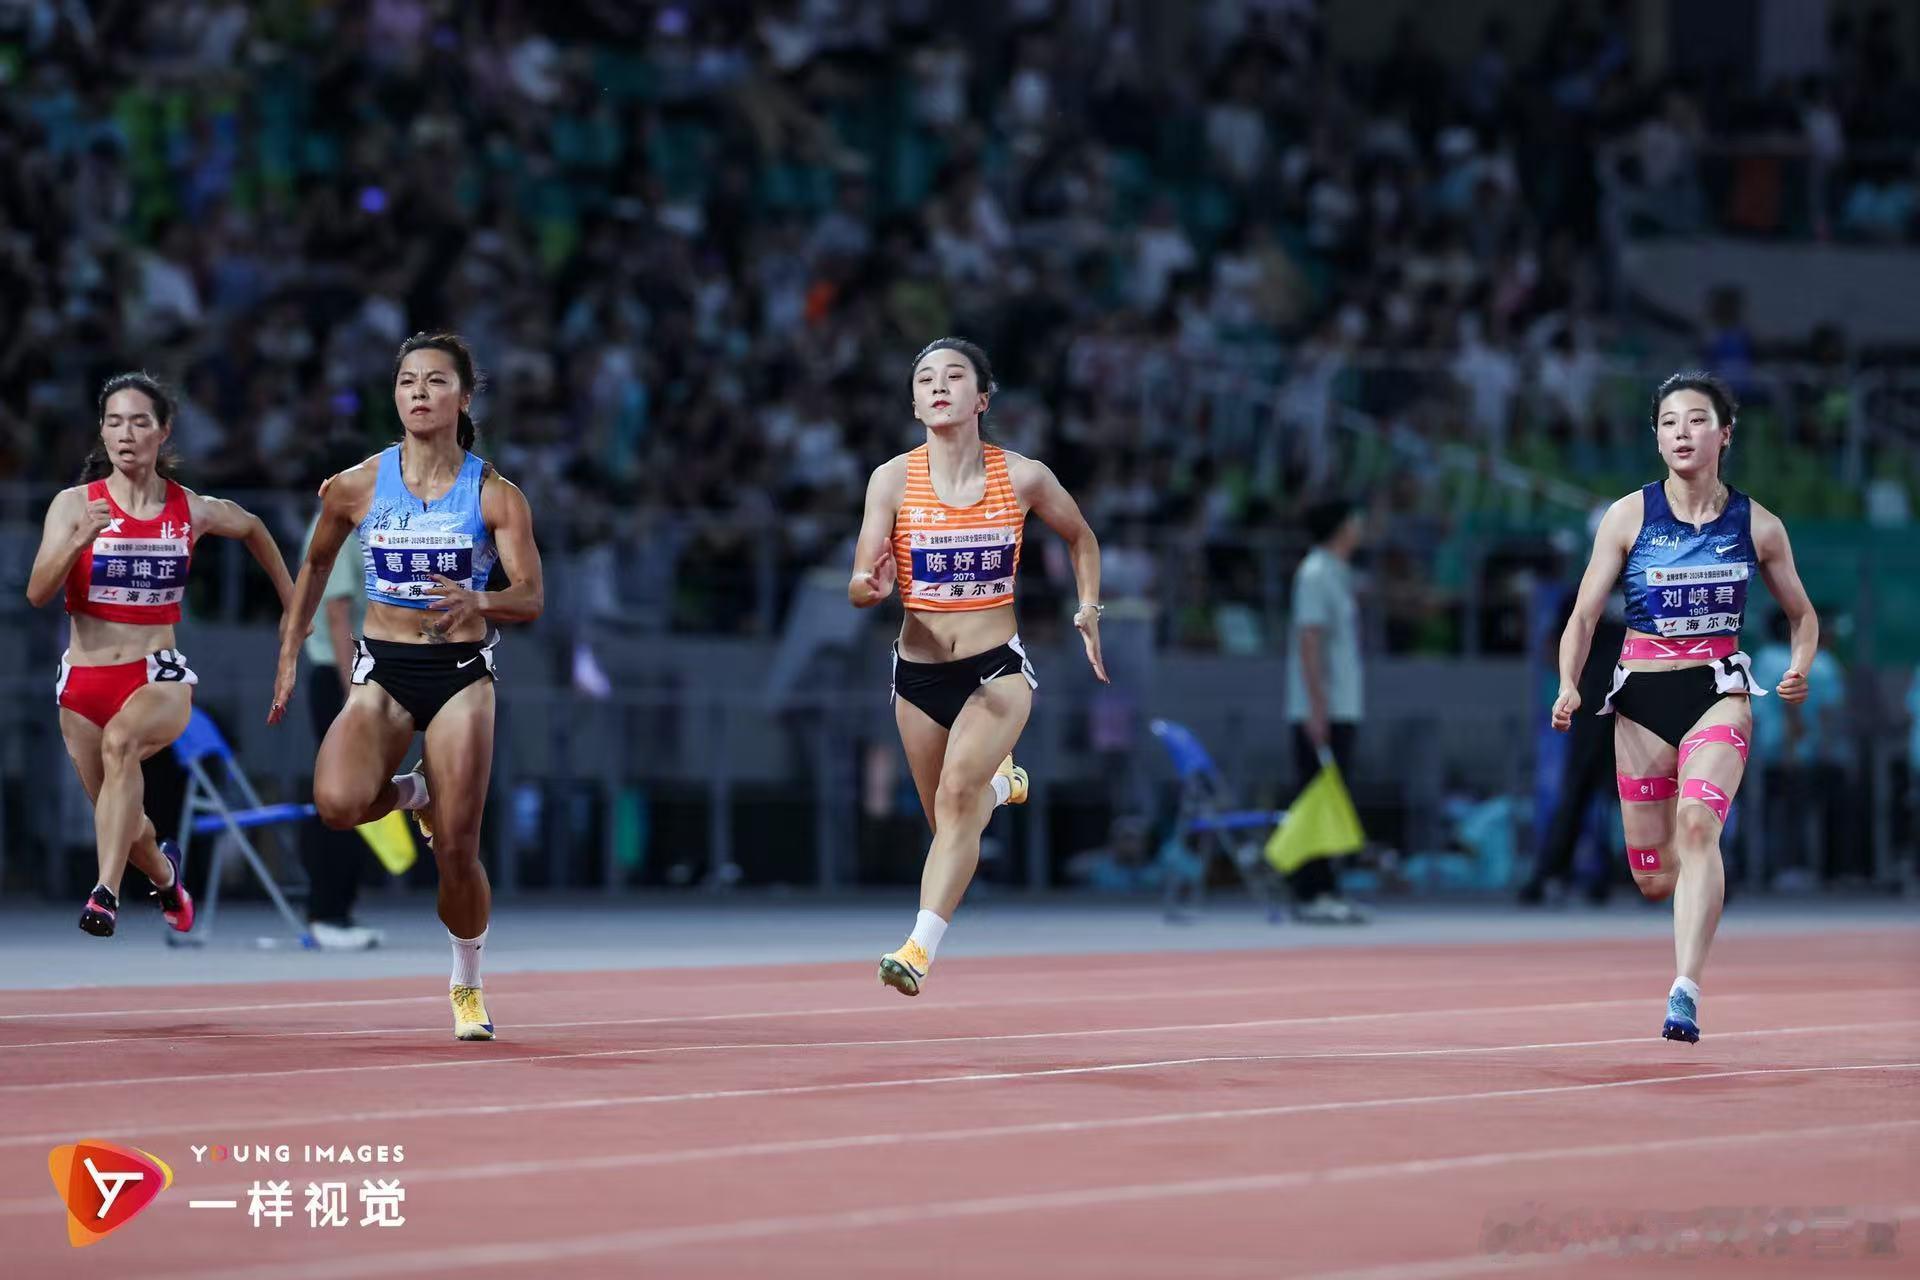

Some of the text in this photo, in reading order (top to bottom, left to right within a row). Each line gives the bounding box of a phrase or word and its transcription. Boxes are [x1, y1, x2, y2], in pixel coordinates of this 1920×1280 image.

[384, 552, 458, 573] 葛曼棋
[926, 550, 1002, 572] 陈妤颉
[131, 580, 151, 588] 1100
[953, 573, 976, 582] 2073
[126, 590, 176, 604] 海尔斯
[949, 582, 1006, 598] 海尔斯
[1661, 585, 1735, 608] 刘峡君
[1689, 606, 1709, 616] 1905
[1686, 615, 1738, 631] 海尔斯
[153, 649, 186, 682] 8
